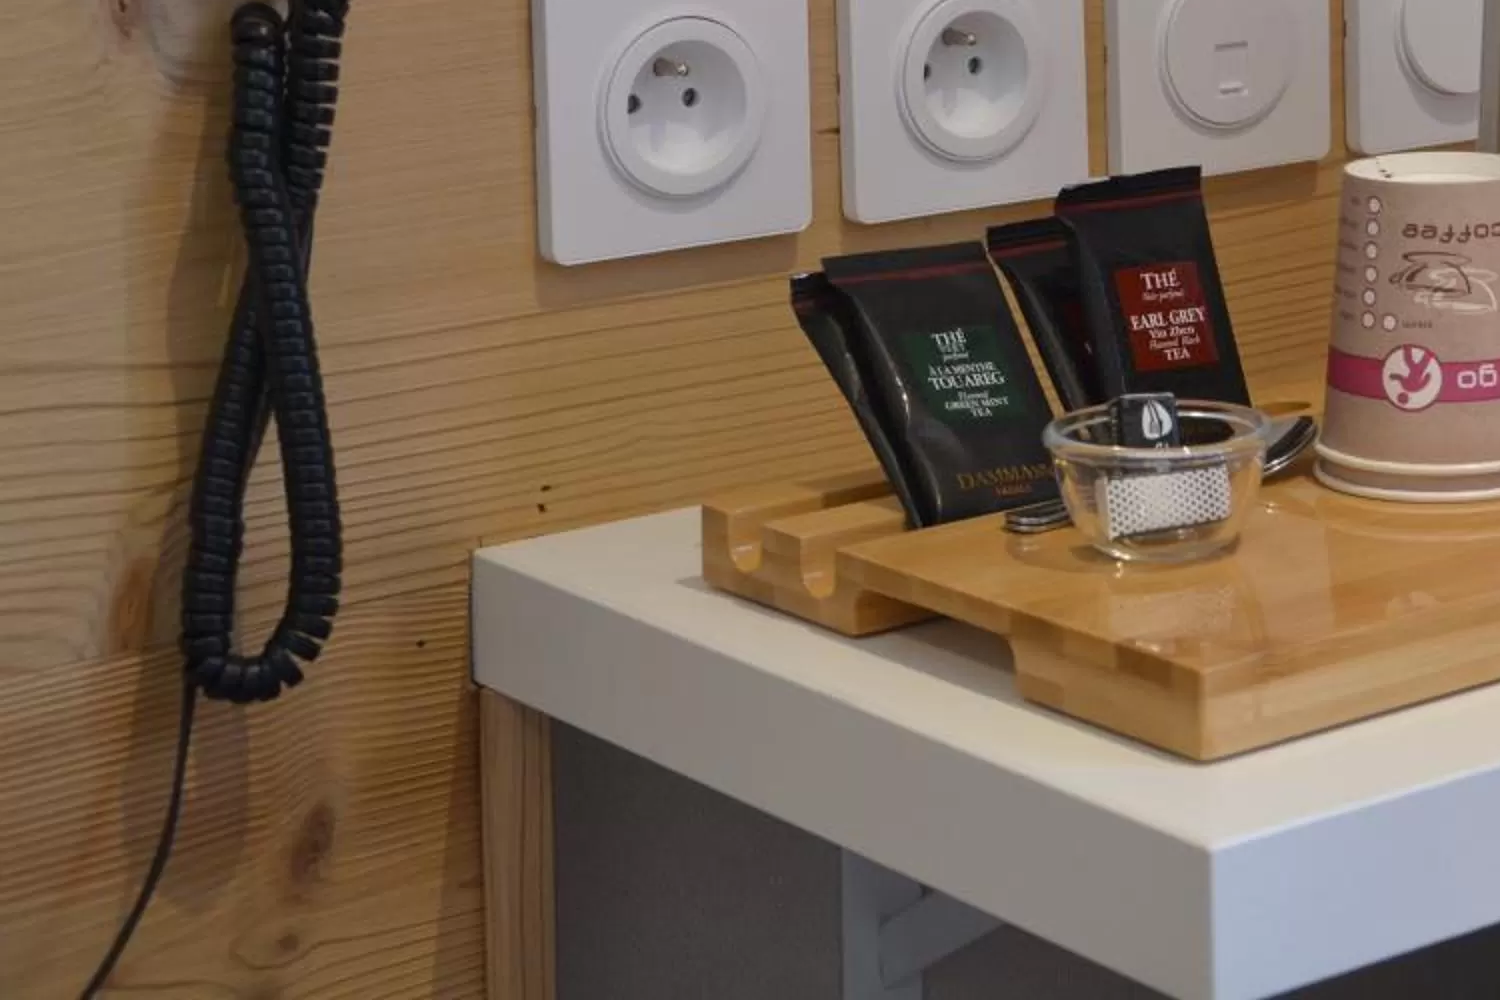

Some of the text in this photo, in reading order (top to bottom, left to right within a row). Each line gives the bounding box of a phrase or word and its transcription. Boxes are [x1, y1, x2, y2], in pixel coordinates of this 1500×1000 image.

[1140, 268, 1180, 290] THÉ
[1130, 306, 1206, 331] EARL GREY
[1163, 346, 1191, 361] TEA
[928, 371, 1006, 391] TOUAREG
[1457, 363, 1498, 388] go
